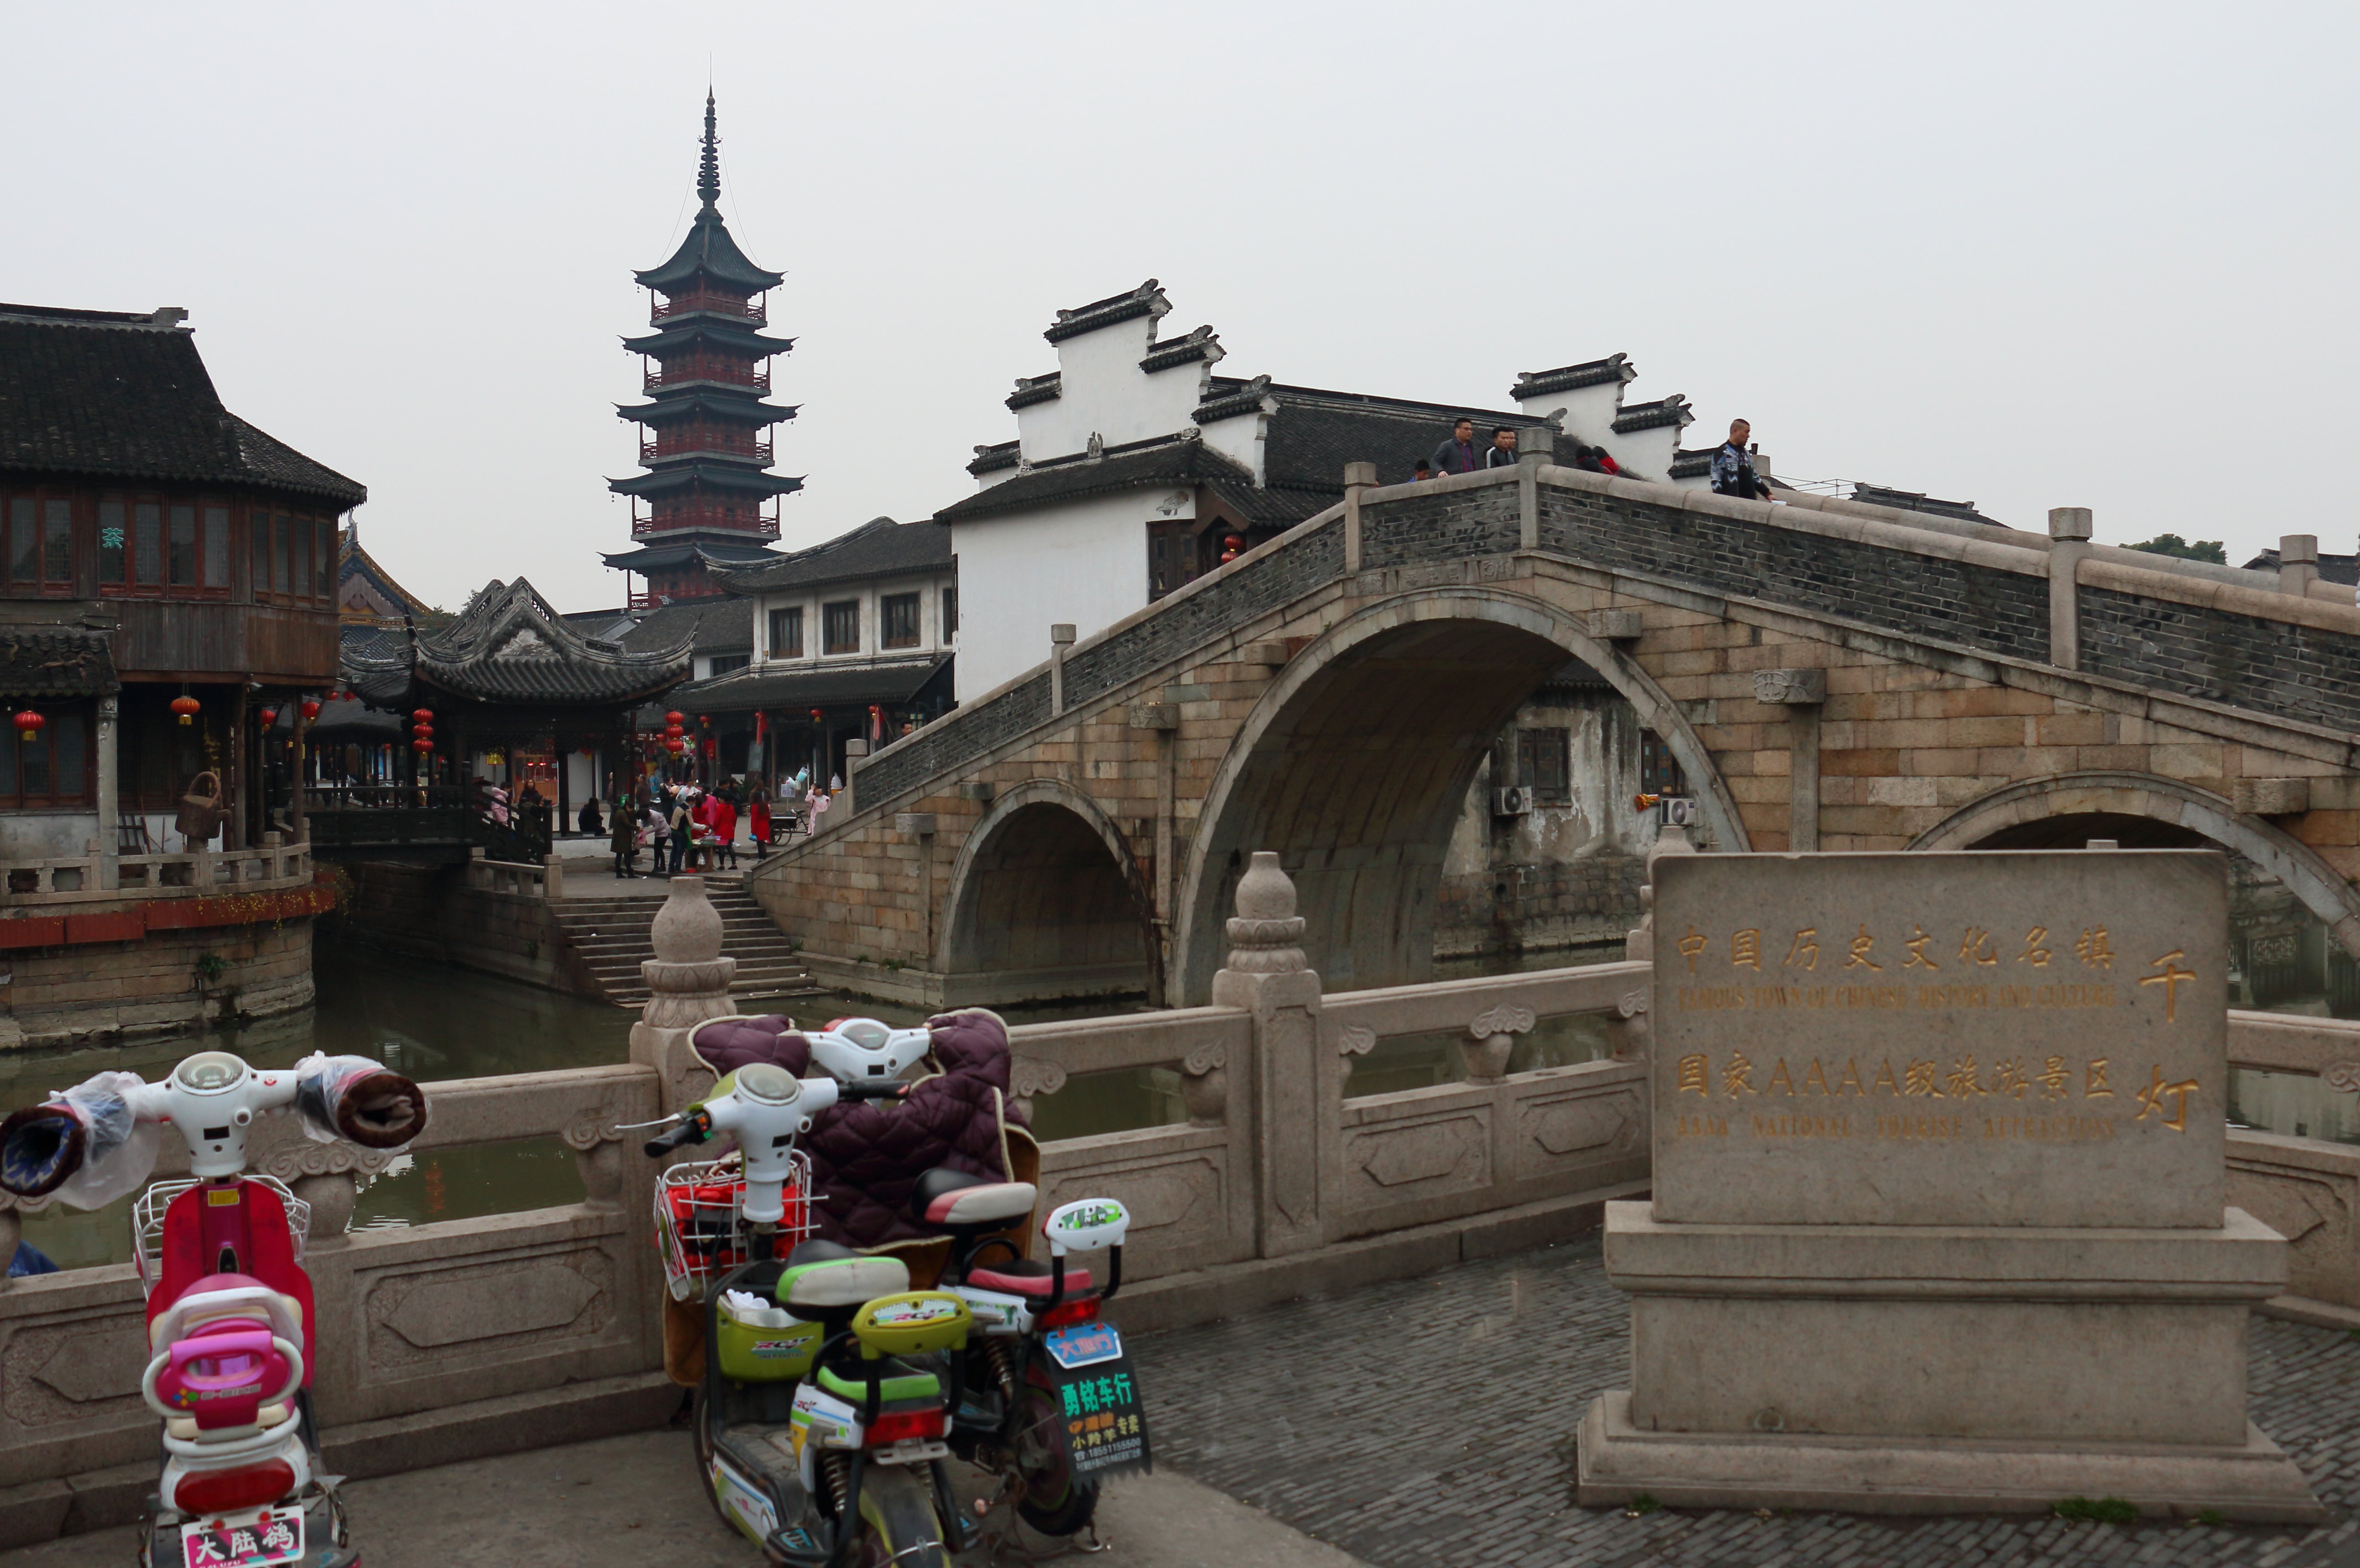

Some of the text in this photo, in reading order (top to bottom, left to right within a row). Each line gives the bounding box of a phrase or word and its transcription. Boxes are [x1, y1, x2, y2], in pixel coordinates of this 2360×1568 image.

[102, 527, 124, 549] 茶
[1677, 923, 2116, 975] 中国历史文化名镇
[1678, 984, 2116, 1010] FAMOUS TOWN OF CHINESE HISTORY AND CULTURE
[2134, 949, 2199, 1134] 千灯
[1677, 1050, 2114, 1100] 国家AAAA级旅游景区
[1677, 1115, 2115, 1140] AAAA NATIONAL TOURIST ATTRACTION
[1061, 1373, 1133, 1417] 勇铭车行
